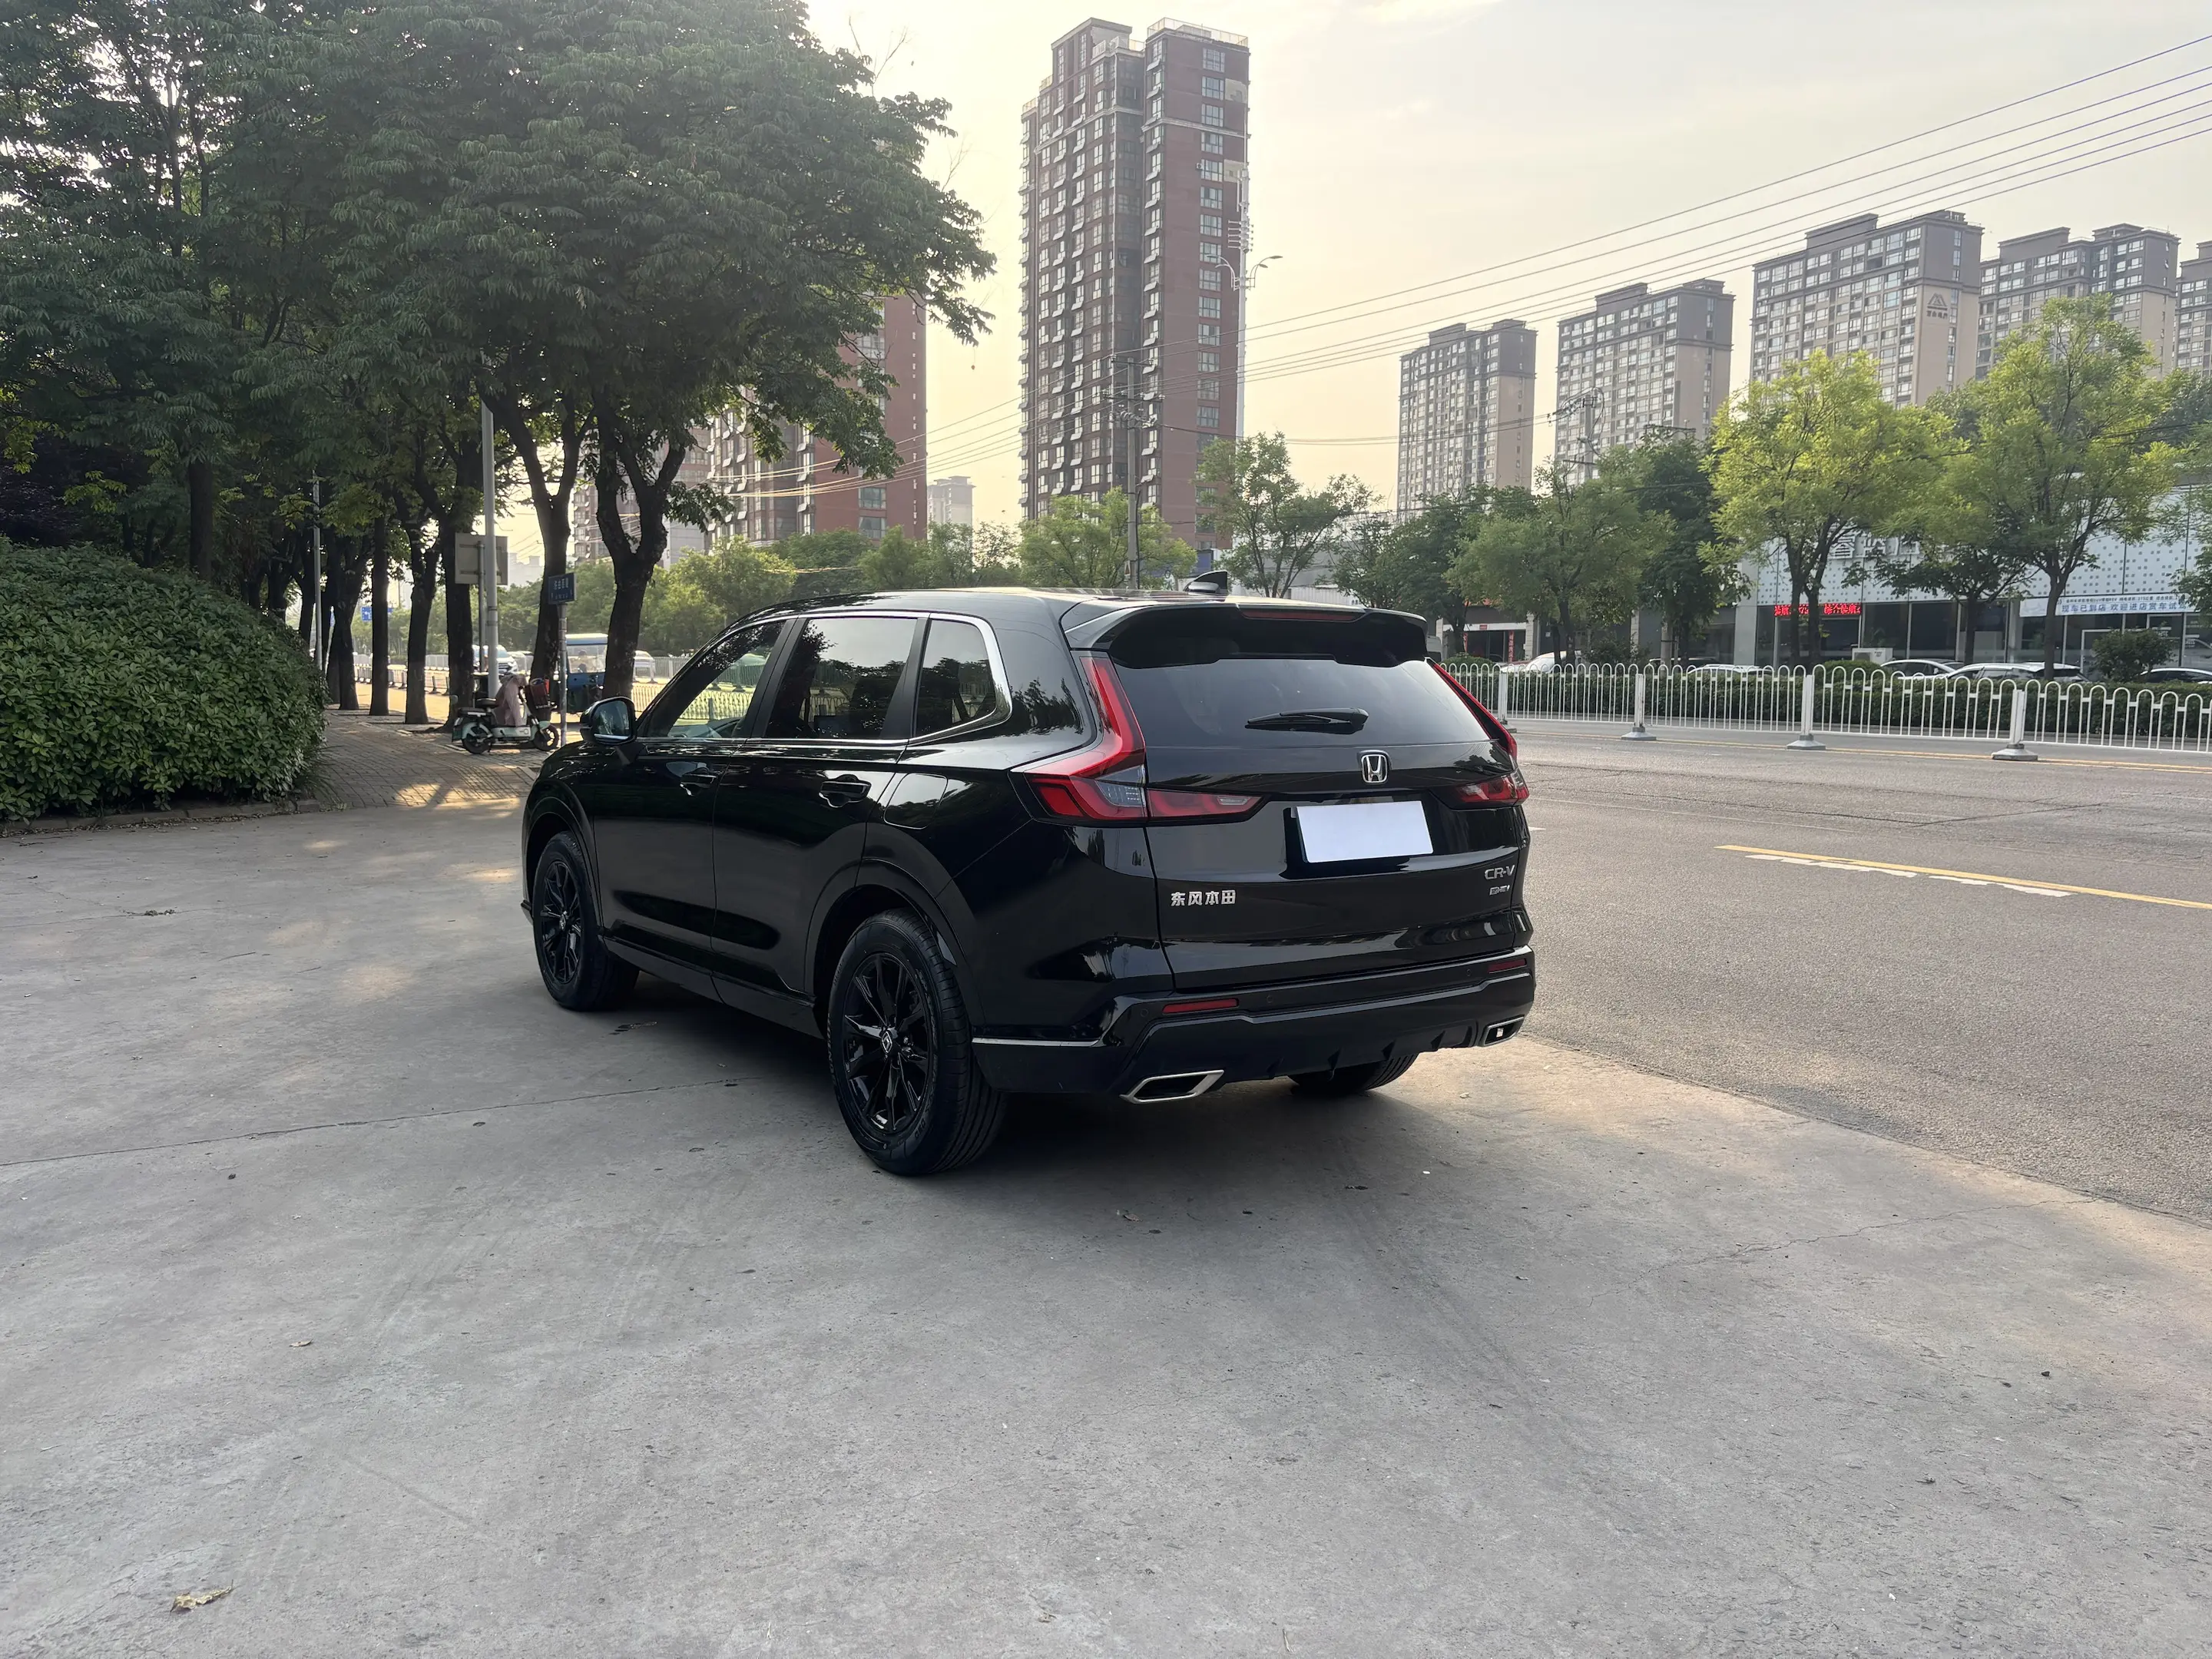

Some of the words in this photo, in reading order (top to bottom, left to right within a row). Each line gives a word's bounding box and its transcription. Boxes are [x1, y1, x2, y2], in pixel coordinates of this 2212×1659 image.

[1485, 865, 1515, 879] CR-V
[1171, 889, 1236, 906] 东风本田
